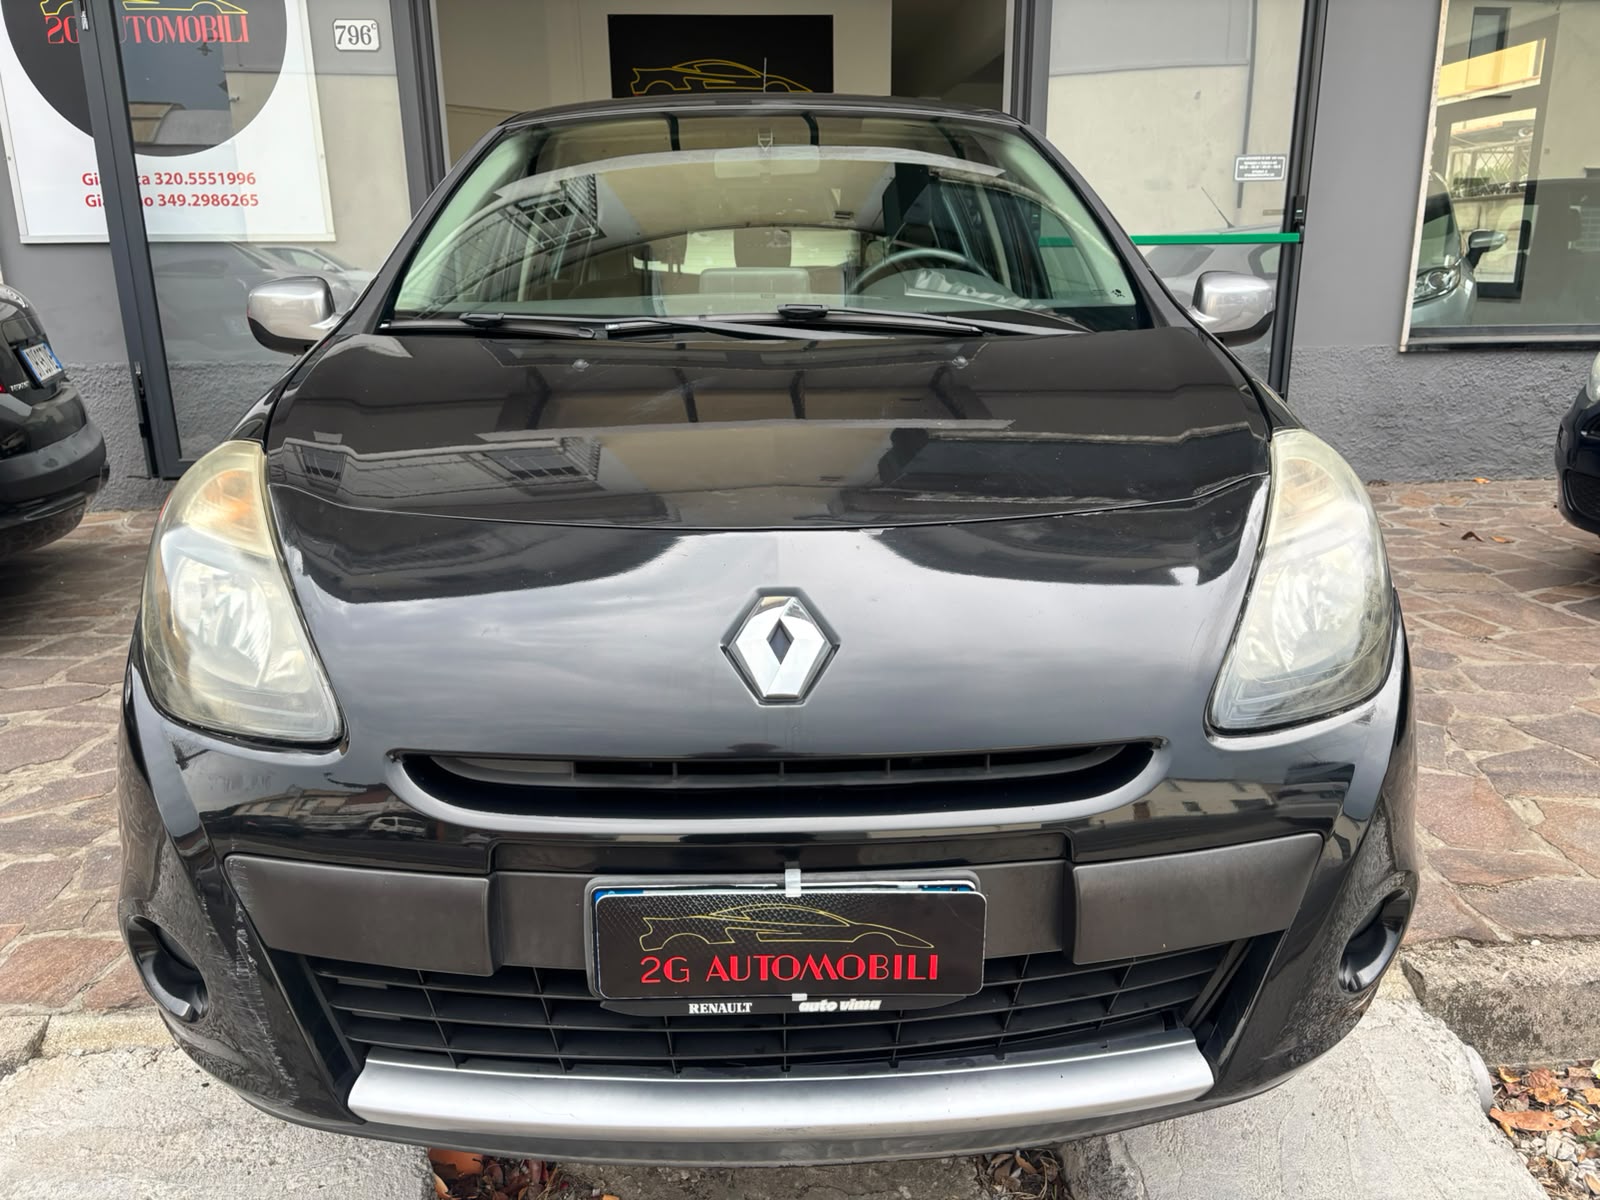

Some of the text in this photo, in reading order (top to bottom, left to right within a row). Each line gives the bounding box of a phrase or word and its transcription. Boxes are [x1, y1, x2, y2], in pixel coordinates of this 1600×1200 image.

[120, 15, 249, 43] TOMOBILI
[154, 172, 257, 186] 320.5551996
[158, 194, 259, 207] 349.2986265
[640, 954, 938, 983] 2G AUTOMOBILI
[689, 1002, 752, 1014] RENAULT
[798, 1000, 838, 1013] auto
